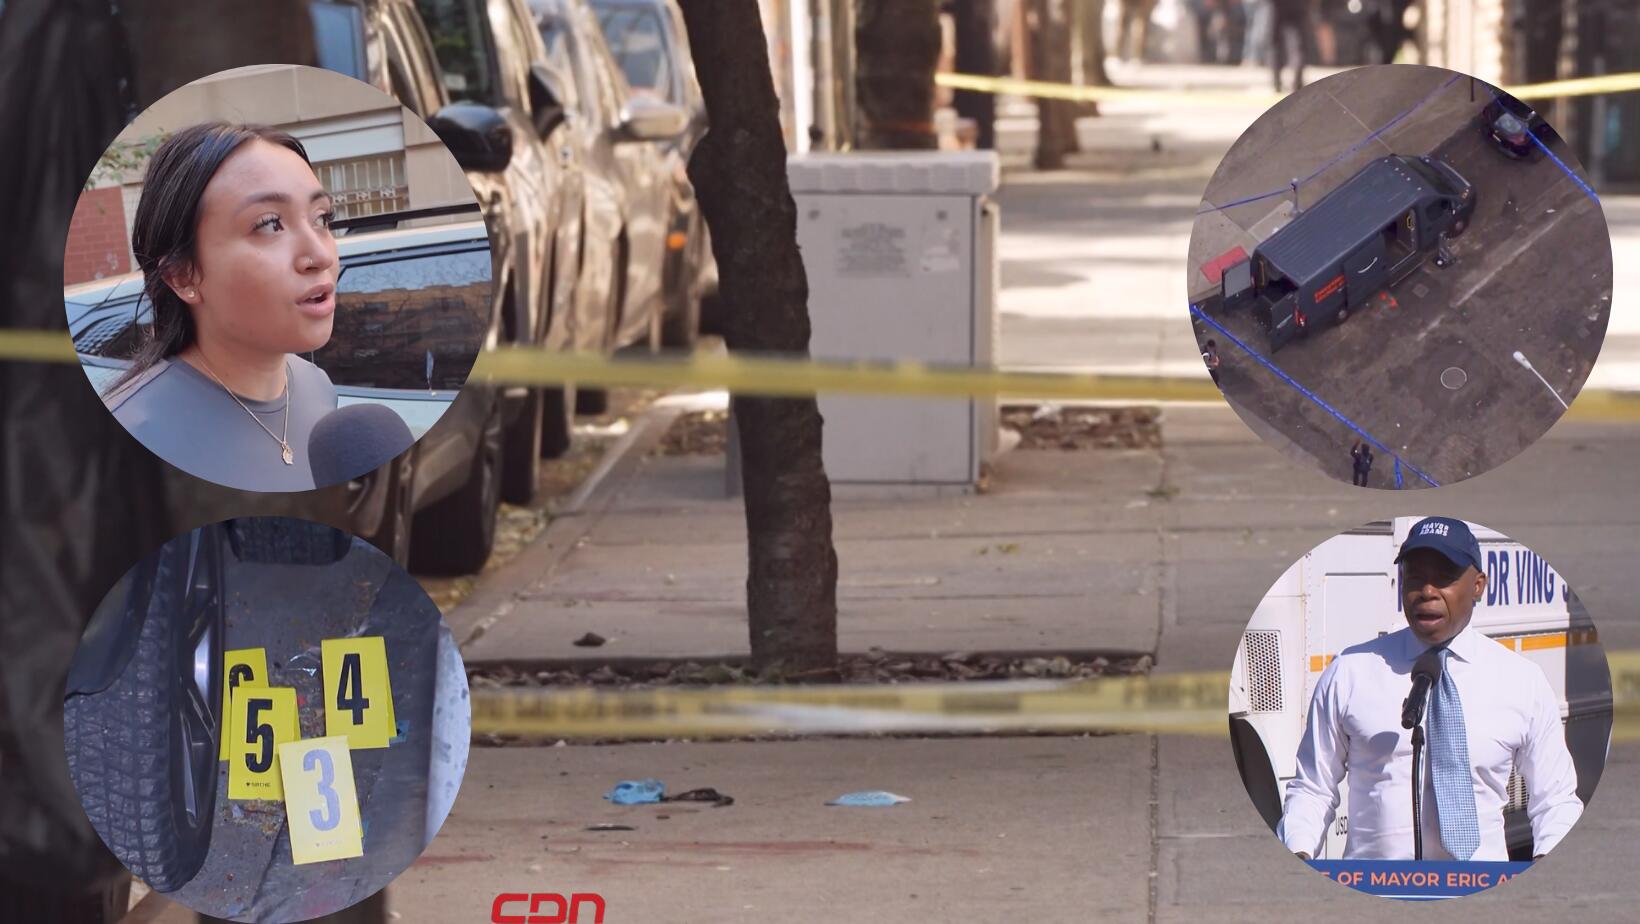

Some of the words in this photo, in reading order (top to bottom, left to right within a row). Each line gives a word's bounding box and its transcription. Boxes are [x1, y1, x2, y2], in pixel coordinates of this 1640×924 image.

[1419, 528, 1449, 537] ADAMS
[1421, 522, 1450, 531] MAYOR
[336, 653, 370, 726] 4
[244, 698, 275, 773] 5
[302, 748, 342, 832] 3
[1337, 871, 1364, 886] OF
[1370, 871, 1440, 887] MAYOR
[1446, 873, 1490, 887] ERIC
